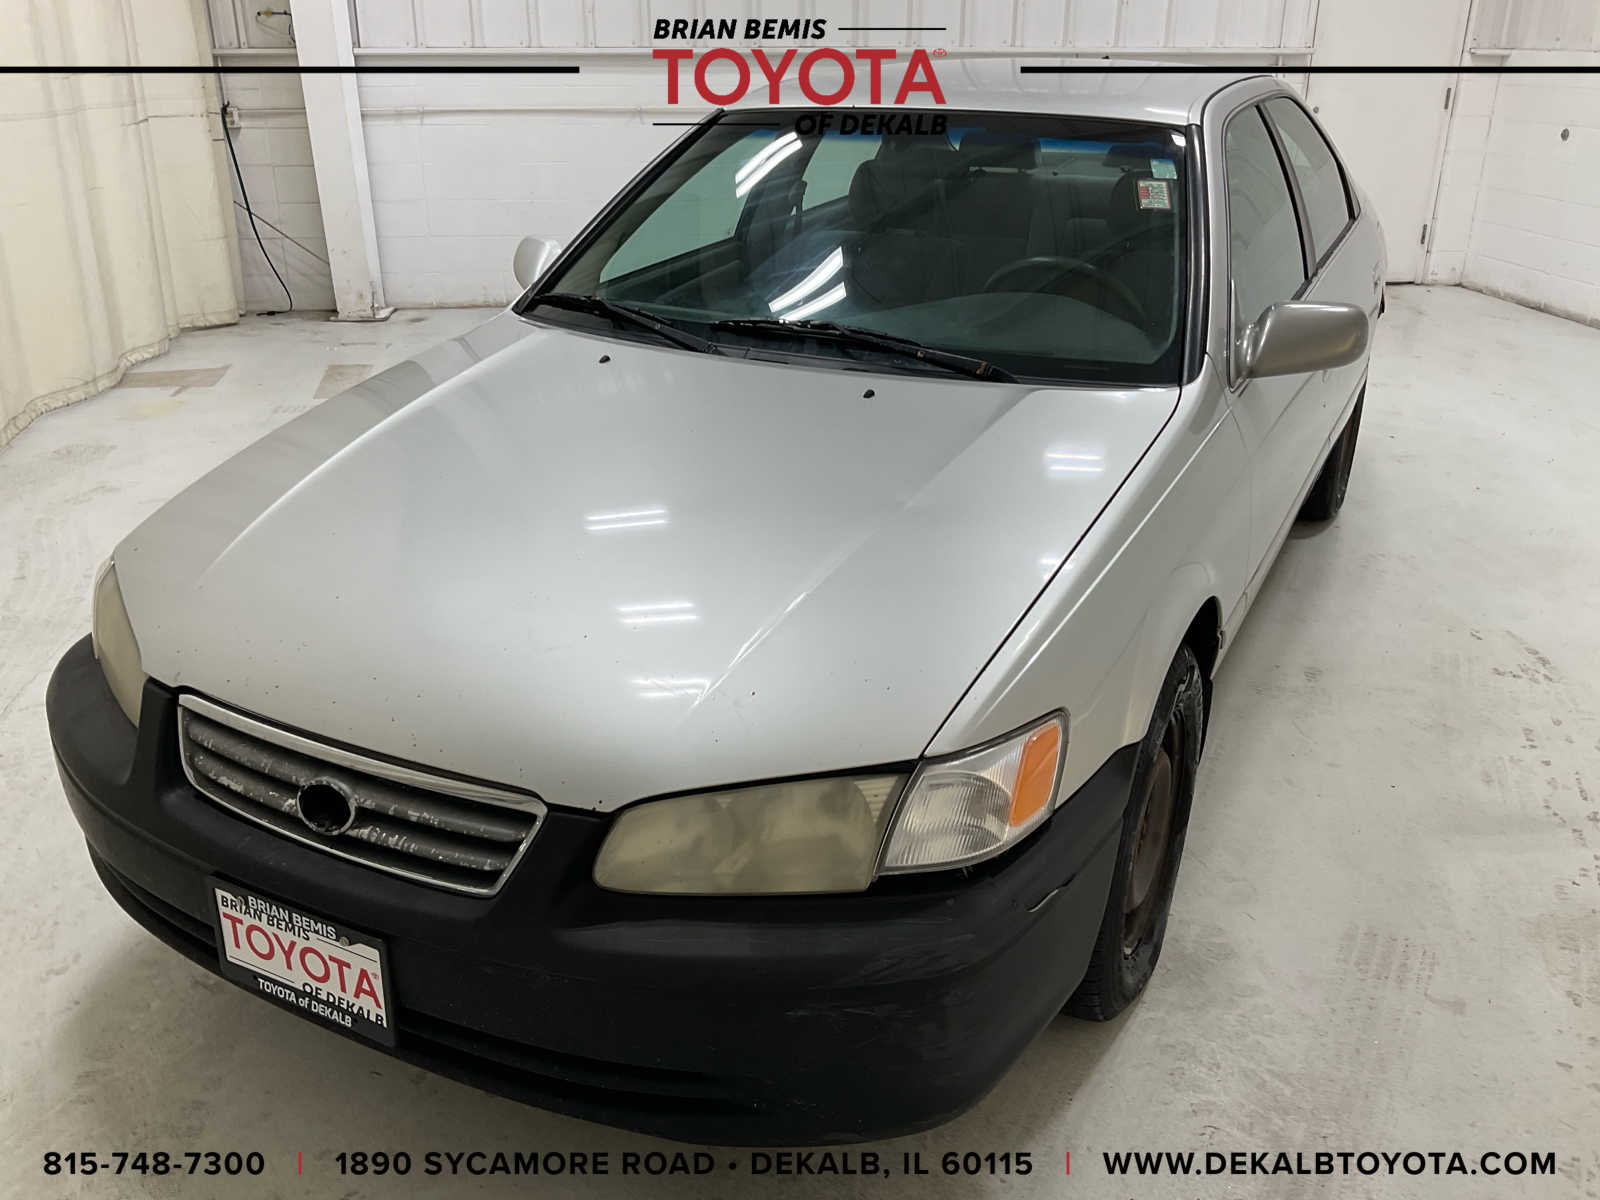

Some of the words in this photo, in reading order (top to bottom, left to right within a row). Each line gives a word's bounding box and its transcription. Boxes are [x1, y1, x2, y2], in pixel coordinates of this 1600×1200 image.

[220, 895, 262, 923] BRIAN
[266, 914, 310, 941] BEMIS
[248, 896, 290, 922] BRIAN
[292, 913, 337, 940] BEMIS
[222, 911, 383, 1010] TOYOTA
[258, 978, 297, 1003] TOYOTA
[298, 997, 310, 1009] of
[311, 1001, 352, 1028] DEKALB
[302, 982, 323, 998] OF
[327, 991, 386, 1026] DEKALB
